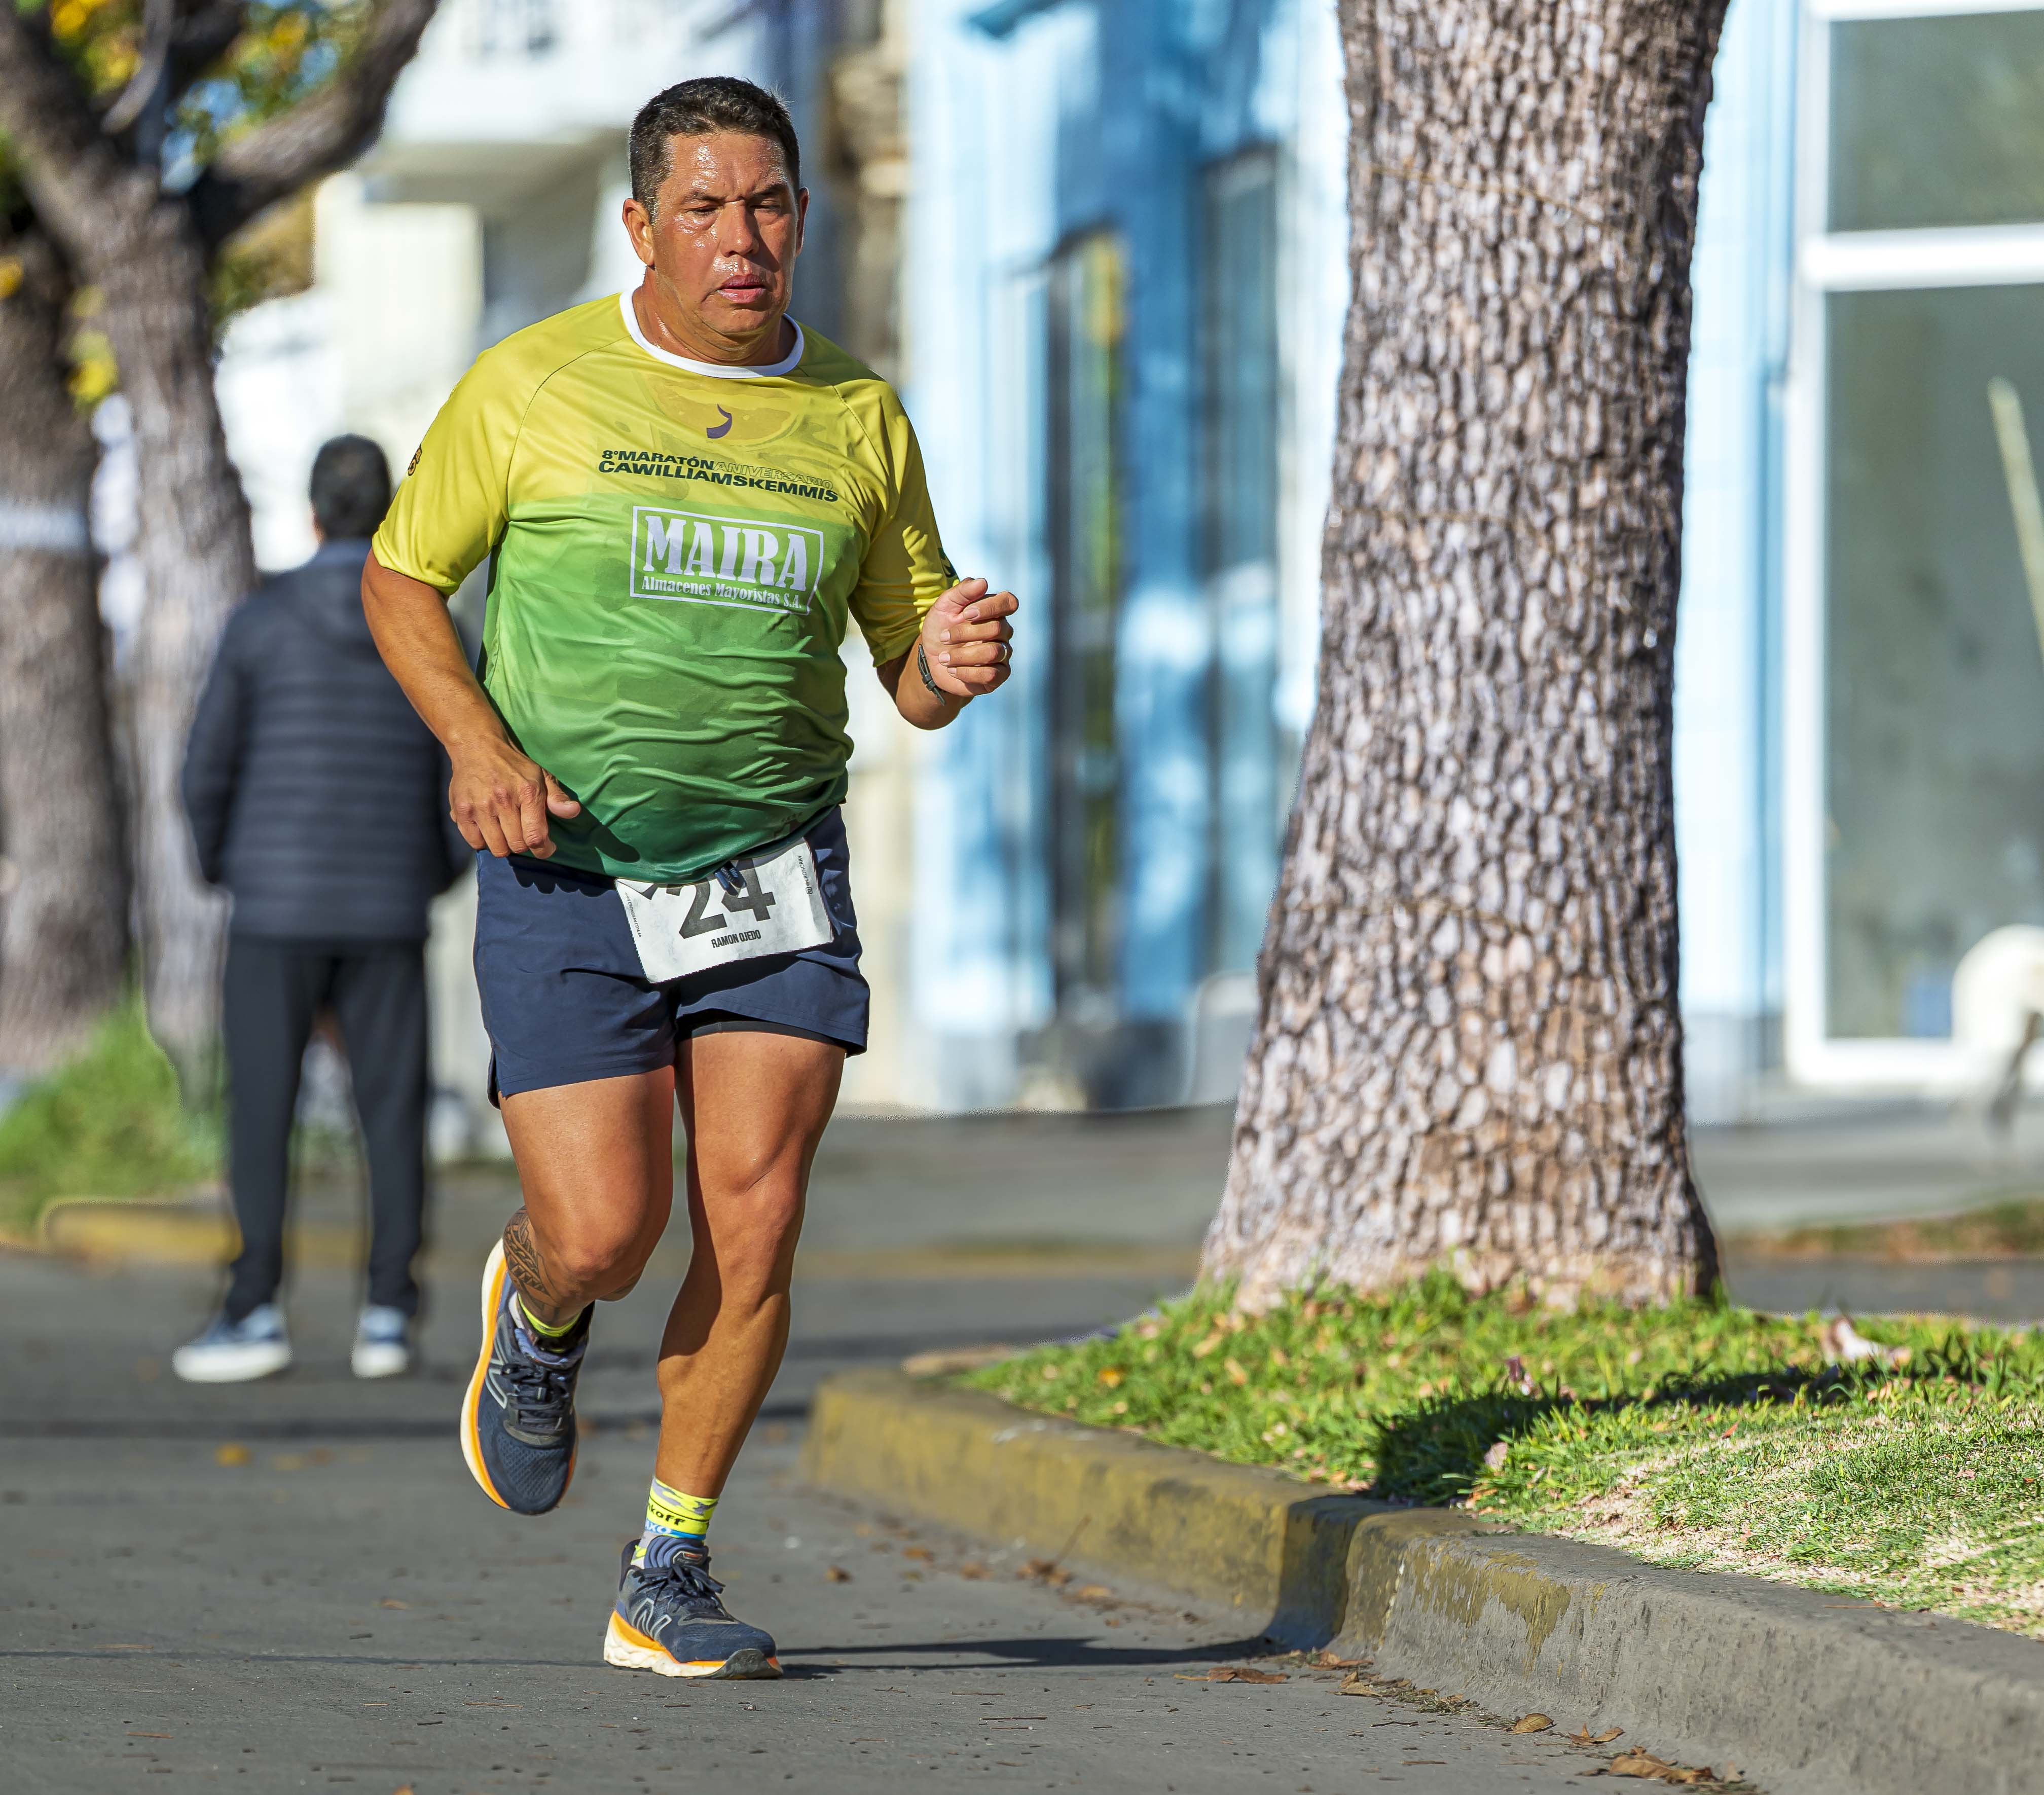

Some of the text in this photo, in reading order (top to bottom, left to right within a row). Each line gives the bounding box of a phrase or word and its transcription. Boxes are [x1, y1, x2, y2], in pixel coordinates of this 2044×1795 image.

[642, 515, 807, 592] MAIRA
[641, 576, 801, 609] Almacenes Mayoristas S.A.
[666, 858, 776, 939] 24
[711, 929, 761, 948] RAMON OJEDO
